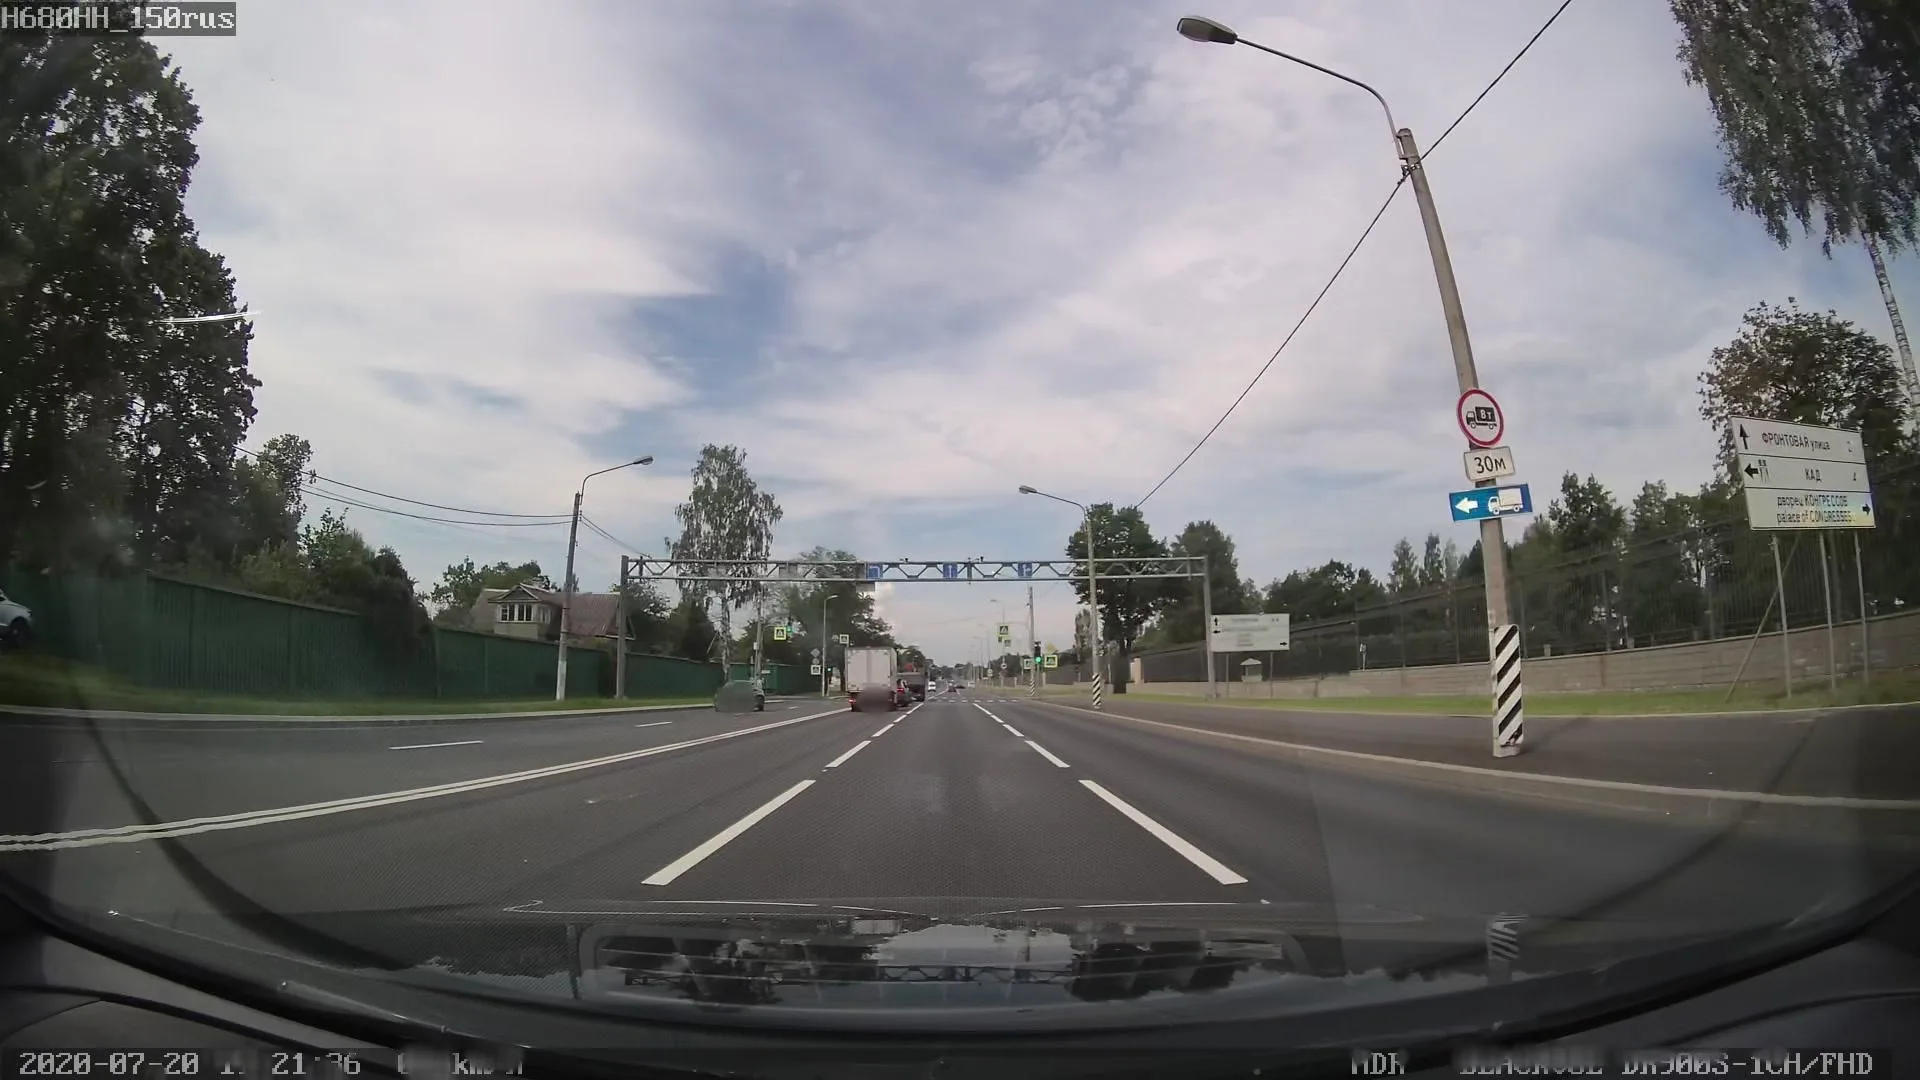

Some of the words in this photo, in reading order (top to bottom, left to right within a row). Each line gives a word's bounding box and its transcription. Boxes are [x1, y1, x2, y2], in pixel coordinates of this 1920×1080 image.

[1761, 432, 1810, 448] ФРОНТОВАЯ
[1810, 440, 1831, 451] улица
[1805, 468, 1822, 482] КАД
